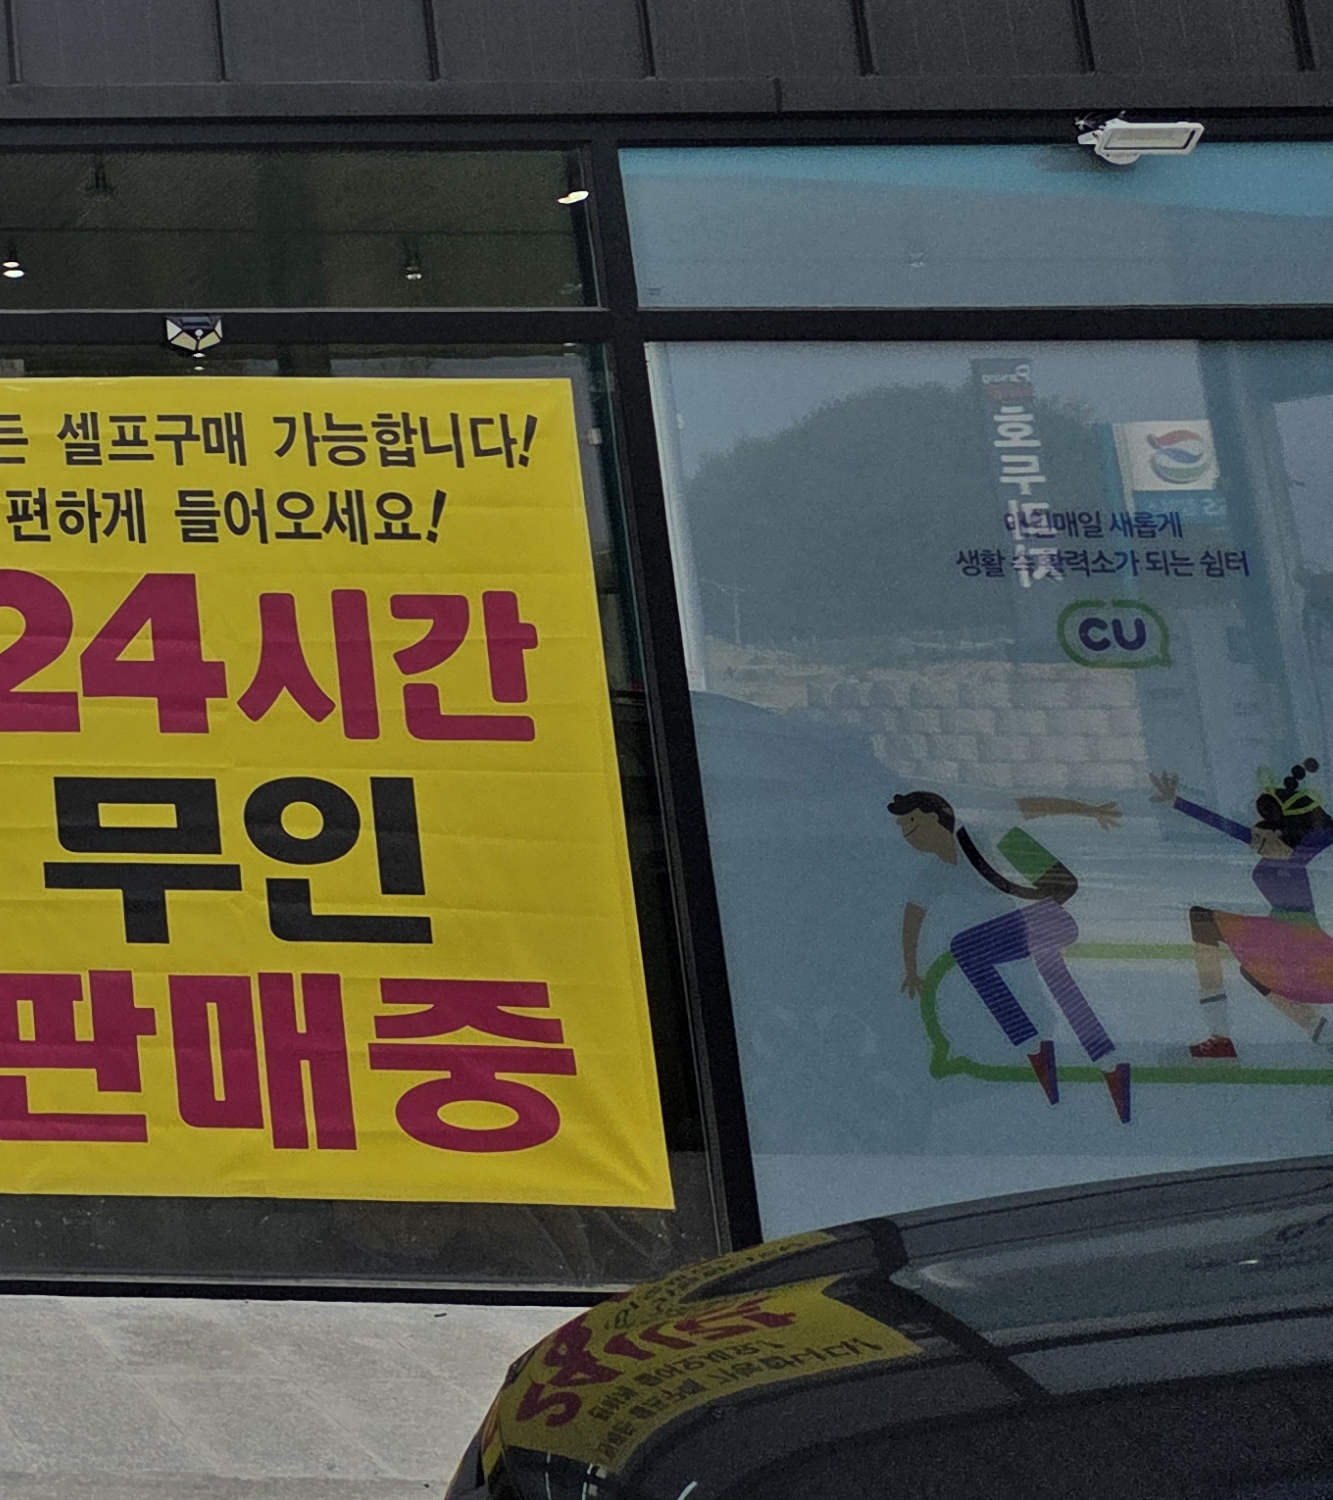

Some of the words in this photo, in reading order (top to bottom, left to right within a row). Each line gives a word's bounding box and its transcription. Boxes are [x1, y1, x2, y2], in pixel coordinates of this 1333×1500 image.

[56, 411, 247, 467] 셀프구매
[272, 411, 538, 469] 가능합니다!
[5, 487, 147, 544] 편하게
[174, 487, 447, 546] 들어오세요!
[1109, 510, 1183, 538] 새롭게
[956, 550, 1005, 578] 생활
[1145, 550, 1194, 578] 되는
[1199, 550, 1250, 578] 쉼터
[1078, 617, 1147, 651] CU
[42, 776, 434, 945] 무인
